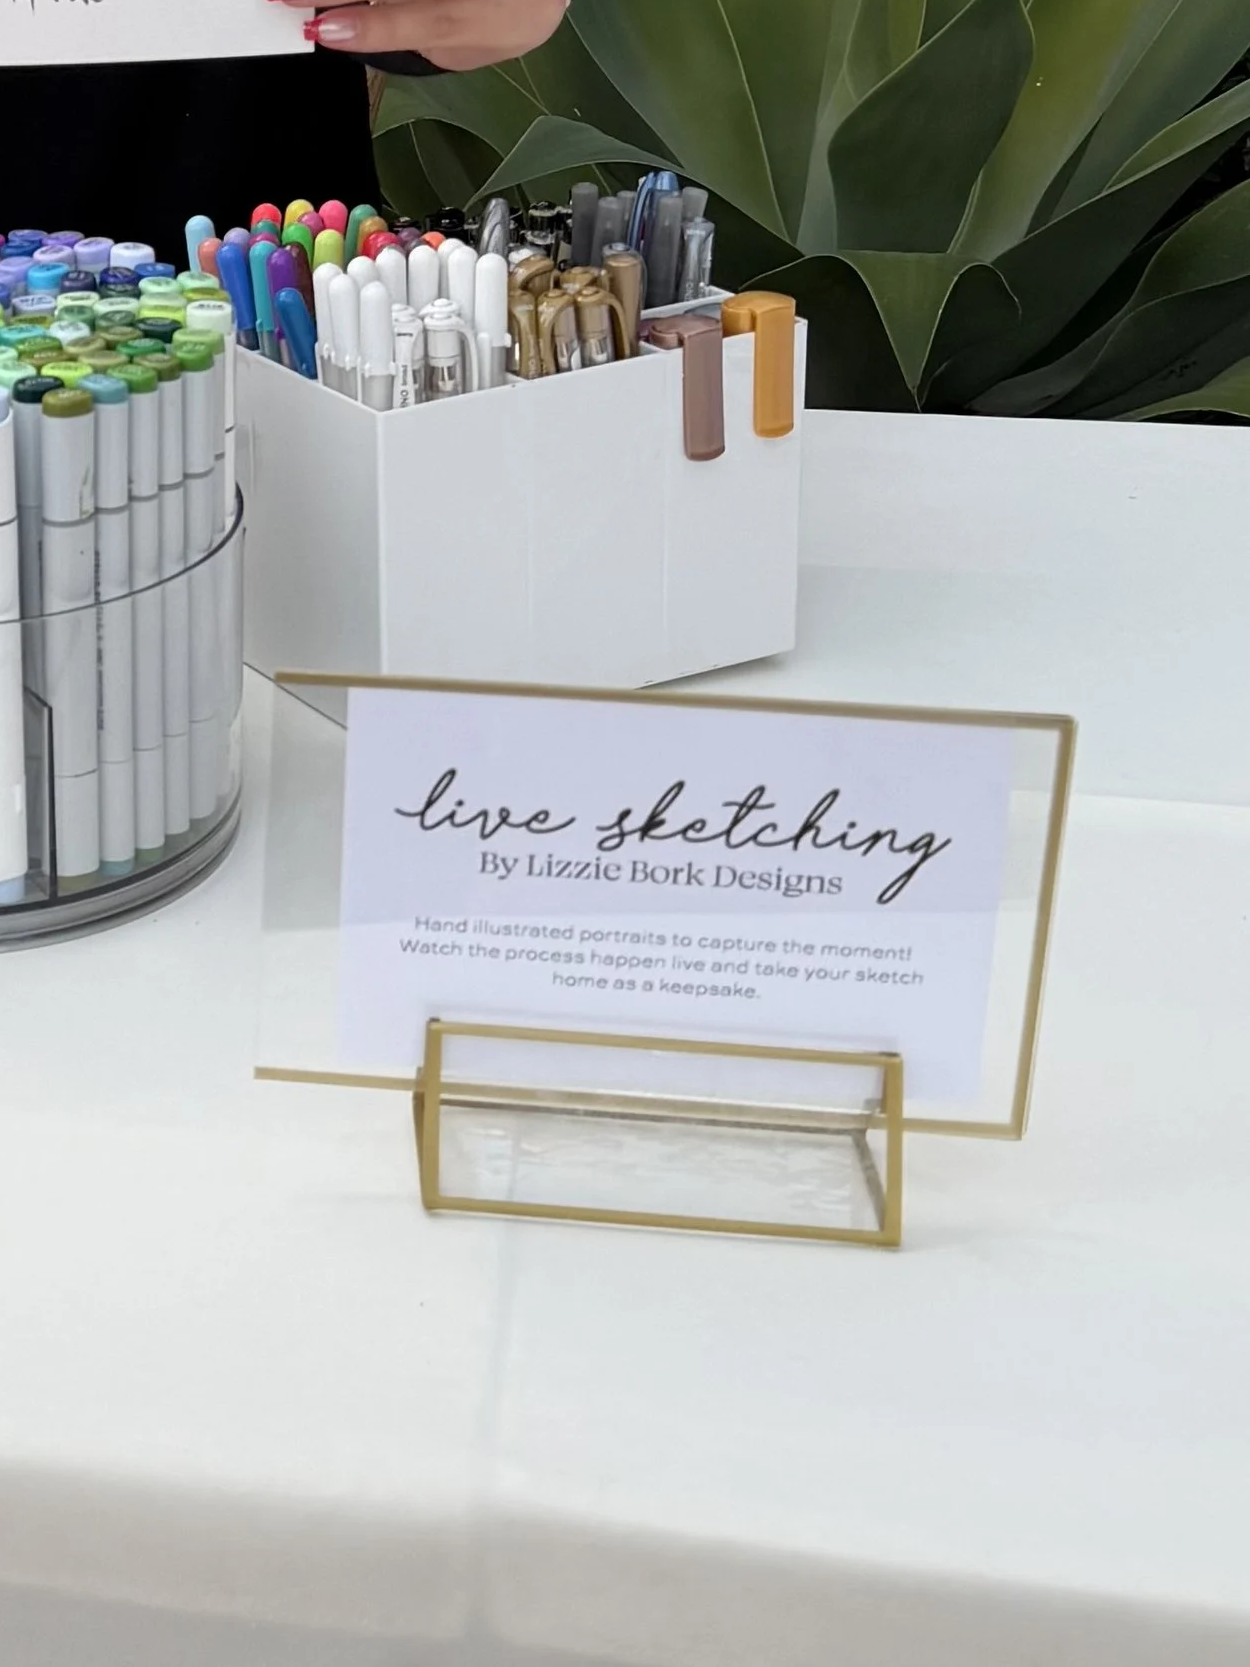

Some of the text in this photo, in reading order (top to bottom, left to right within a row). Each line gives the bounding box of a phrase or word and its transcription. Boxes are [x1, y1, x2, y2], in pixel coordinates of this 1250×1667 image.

[395, 767, 952, 905] live sketching
[480, 851, 844, 898] By Lizzie Bork Designs
[399, 938, 925, 987] Watch the process happen live and take your sketch
[414, 916, 913, 962] Hand illustrated portraits to capture the moment!
[552, 971, 762, 1000] home as a keepsake.
